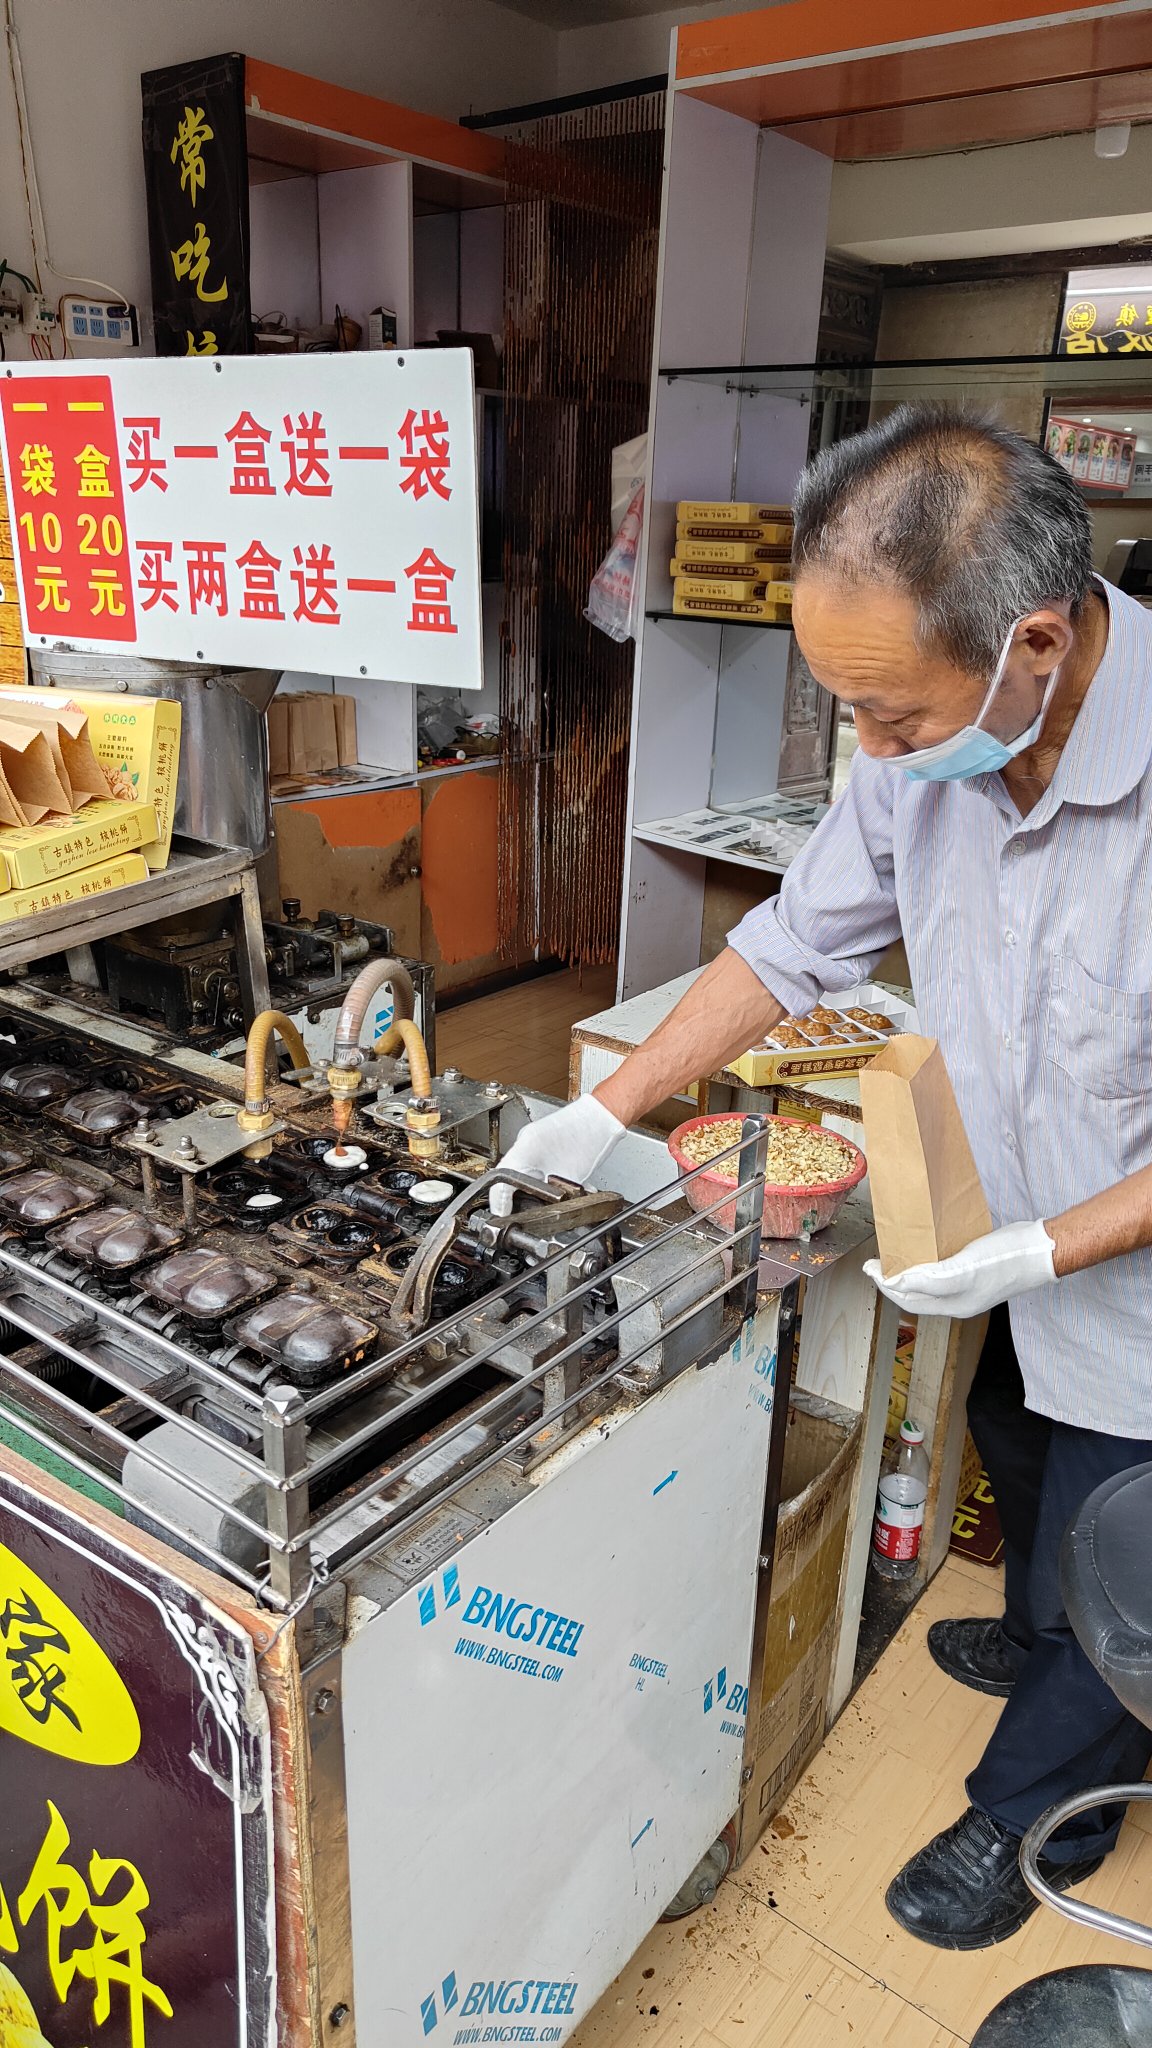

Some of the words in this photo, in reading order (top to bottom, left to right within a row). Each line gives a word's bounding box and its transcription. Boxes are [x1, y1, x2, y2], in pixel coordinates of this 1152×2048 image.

[123, 408, 453, 502] 买一盒送一袋
[135, 539, 459, 634] 买两盒送一盒
[462, 1586, 585, 1657] BNGSTEEL
[454, 1637, 564, 1683] WWW.BNGSTEEL.COM
[628, 1653, 669, 1678] BNGSTEEL
[459, 1980, 579, 2017] BNGSTEEL
[453, 2026, 563, 2046] WWW.BNGSTEEL.COM
